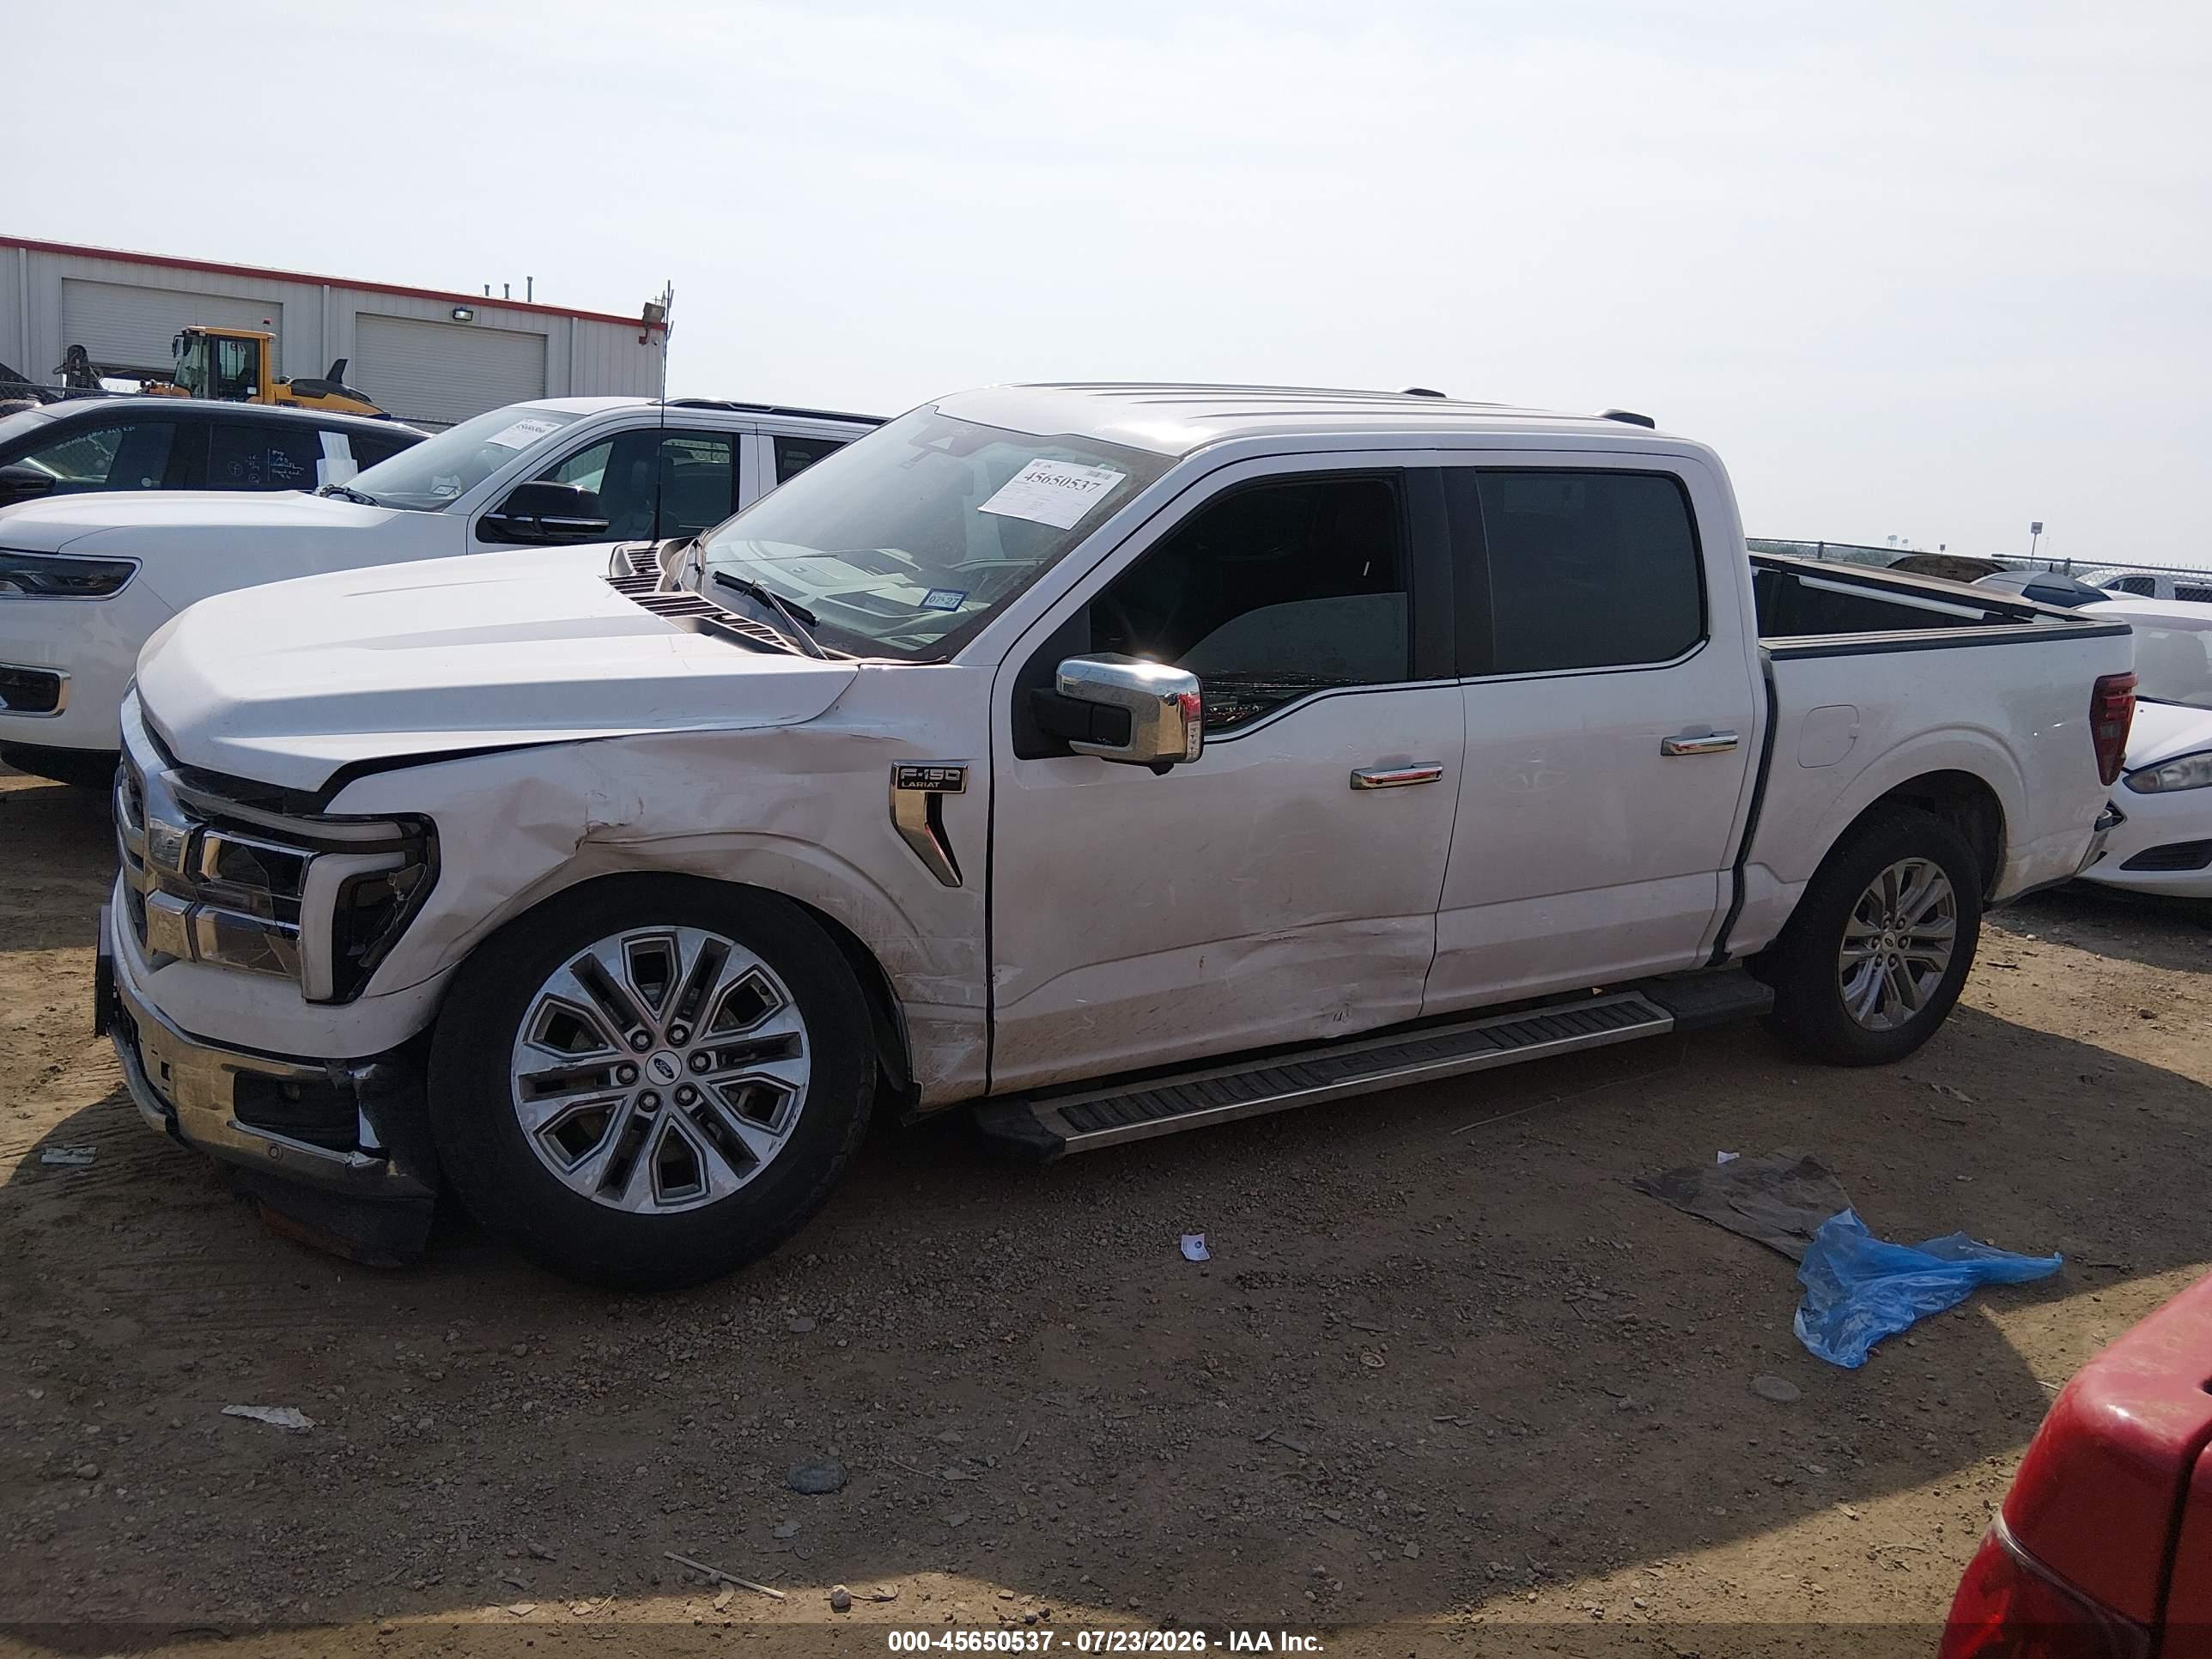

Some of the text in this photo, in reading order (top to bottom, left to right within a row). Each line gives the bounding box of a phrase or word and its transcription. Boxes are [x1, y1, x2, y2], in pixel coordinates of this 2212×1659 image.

[1024, 471, 1102, 493] 45650537
[900, 768, 961, 781] F-150
[655, 1060, 672, 1077] Ford
